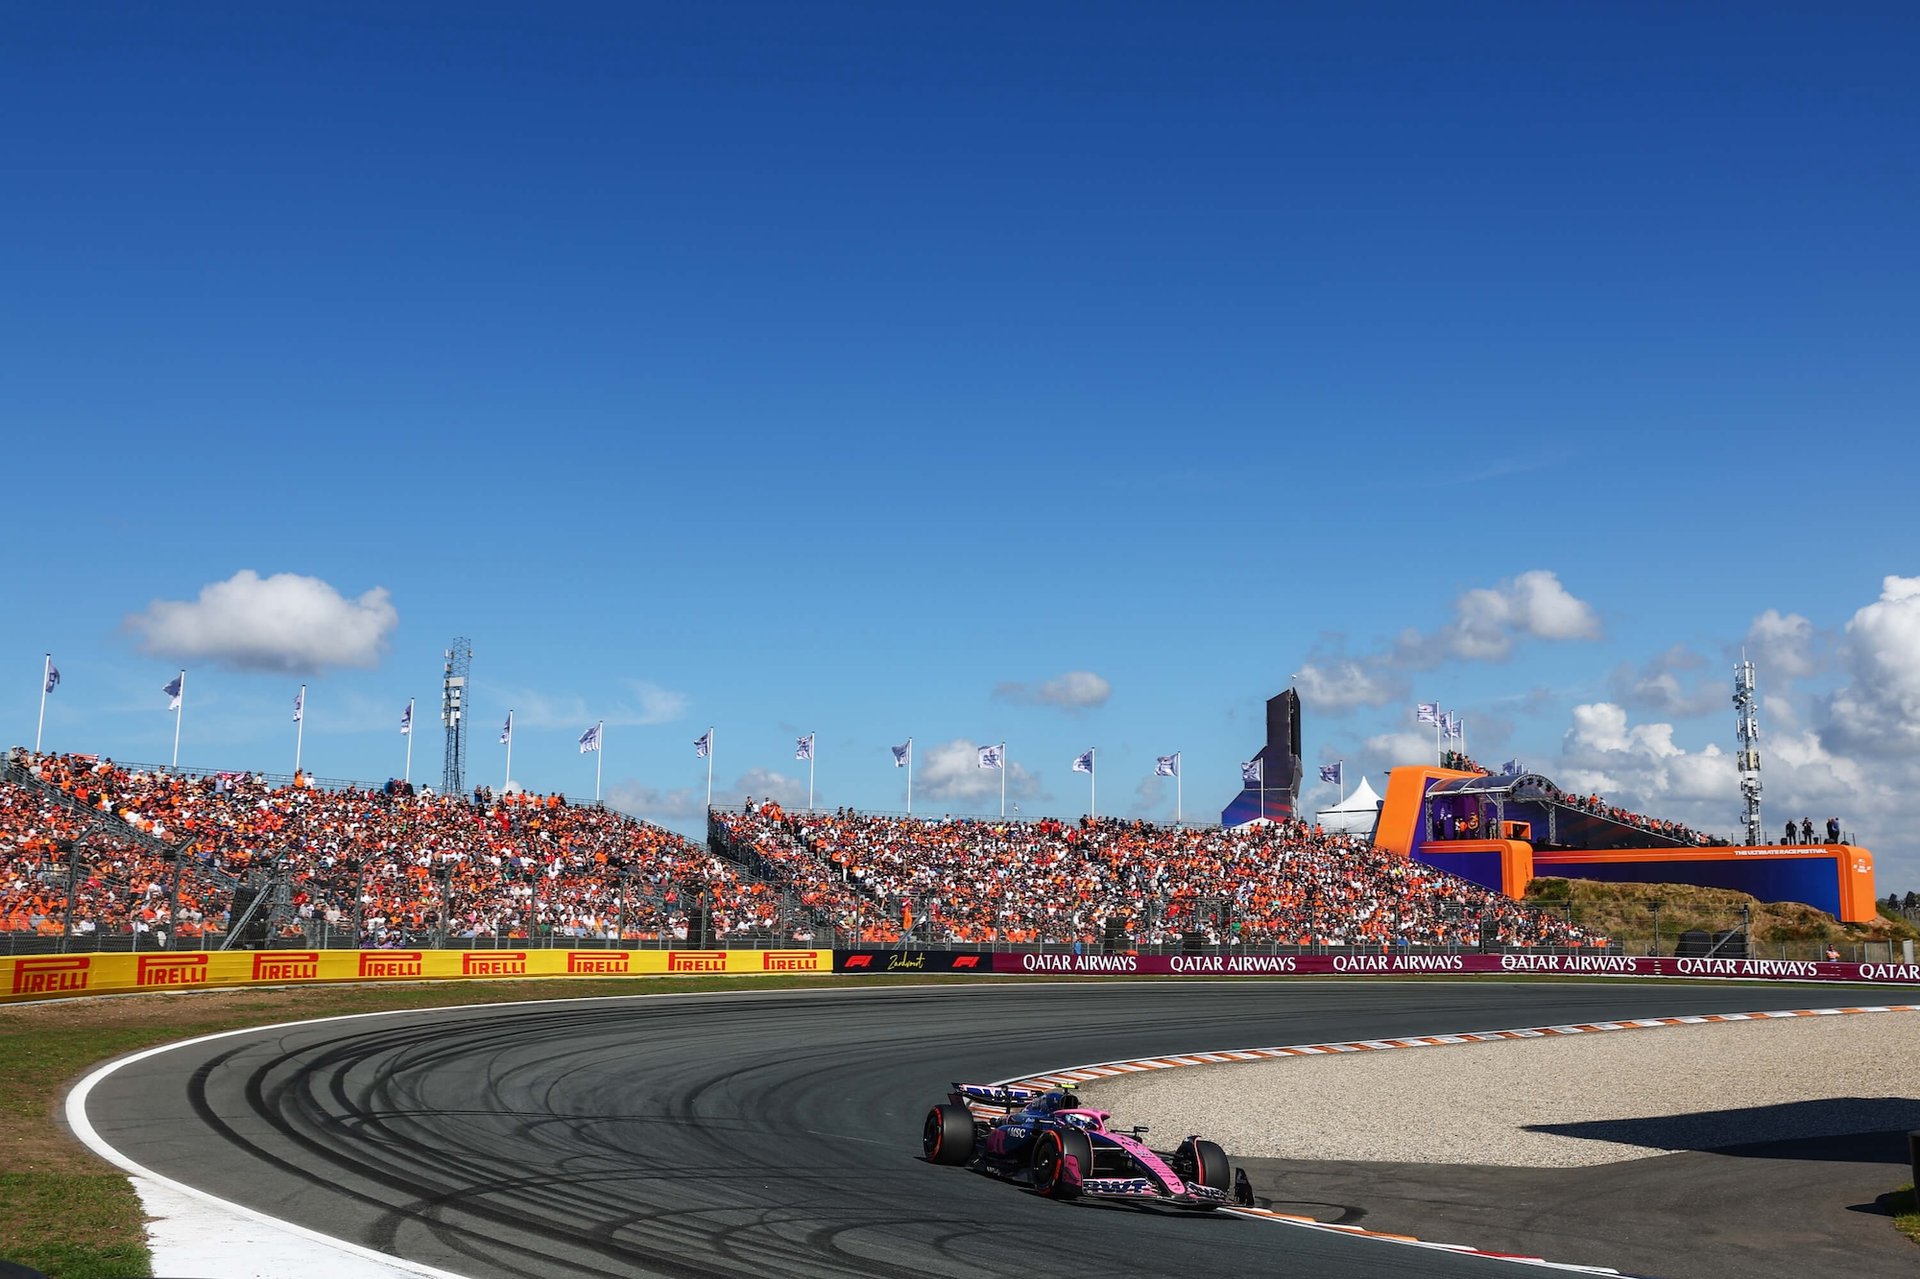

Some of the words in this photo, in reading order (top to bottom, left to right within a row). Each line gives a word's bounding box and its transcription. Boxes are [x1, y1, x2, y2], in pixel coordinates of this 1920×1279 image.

[136, 953, 209, 986] PIRELLI
[252, 952, 319, 981] PIRELLI
[359, 952, 422, 977] PIRELLI
[462, 952, 527, 975] PIRELLI
[567, 952, 629, 973] PIRELLI
[668, 951, 727, 971] PIRELLI
[763, 951, 818, 970] PIRELLI
[1023, 954, 1072, 971] QATAR
[1074, 954, 1137, 971] AIRWAYS
[1170, 955, 1224, 972] QATAR
[1227, 956, 1297, 972] AIRWAYS
[1333, 955, 1389, 971] QATAR
[1392, 955, 1463, 970] AIRWAYS
[1501, 954, 1560, 970] QATAR
[1563, 955, 1637, 972] AIRWAYS
[1677, 957, 1738, 975] QATAR
[1741, 959, 1818, 977] AIRWAYS
[12, 956, 90, 994] PIRELLI
[1859, 963, 1920, 980] QATAR
